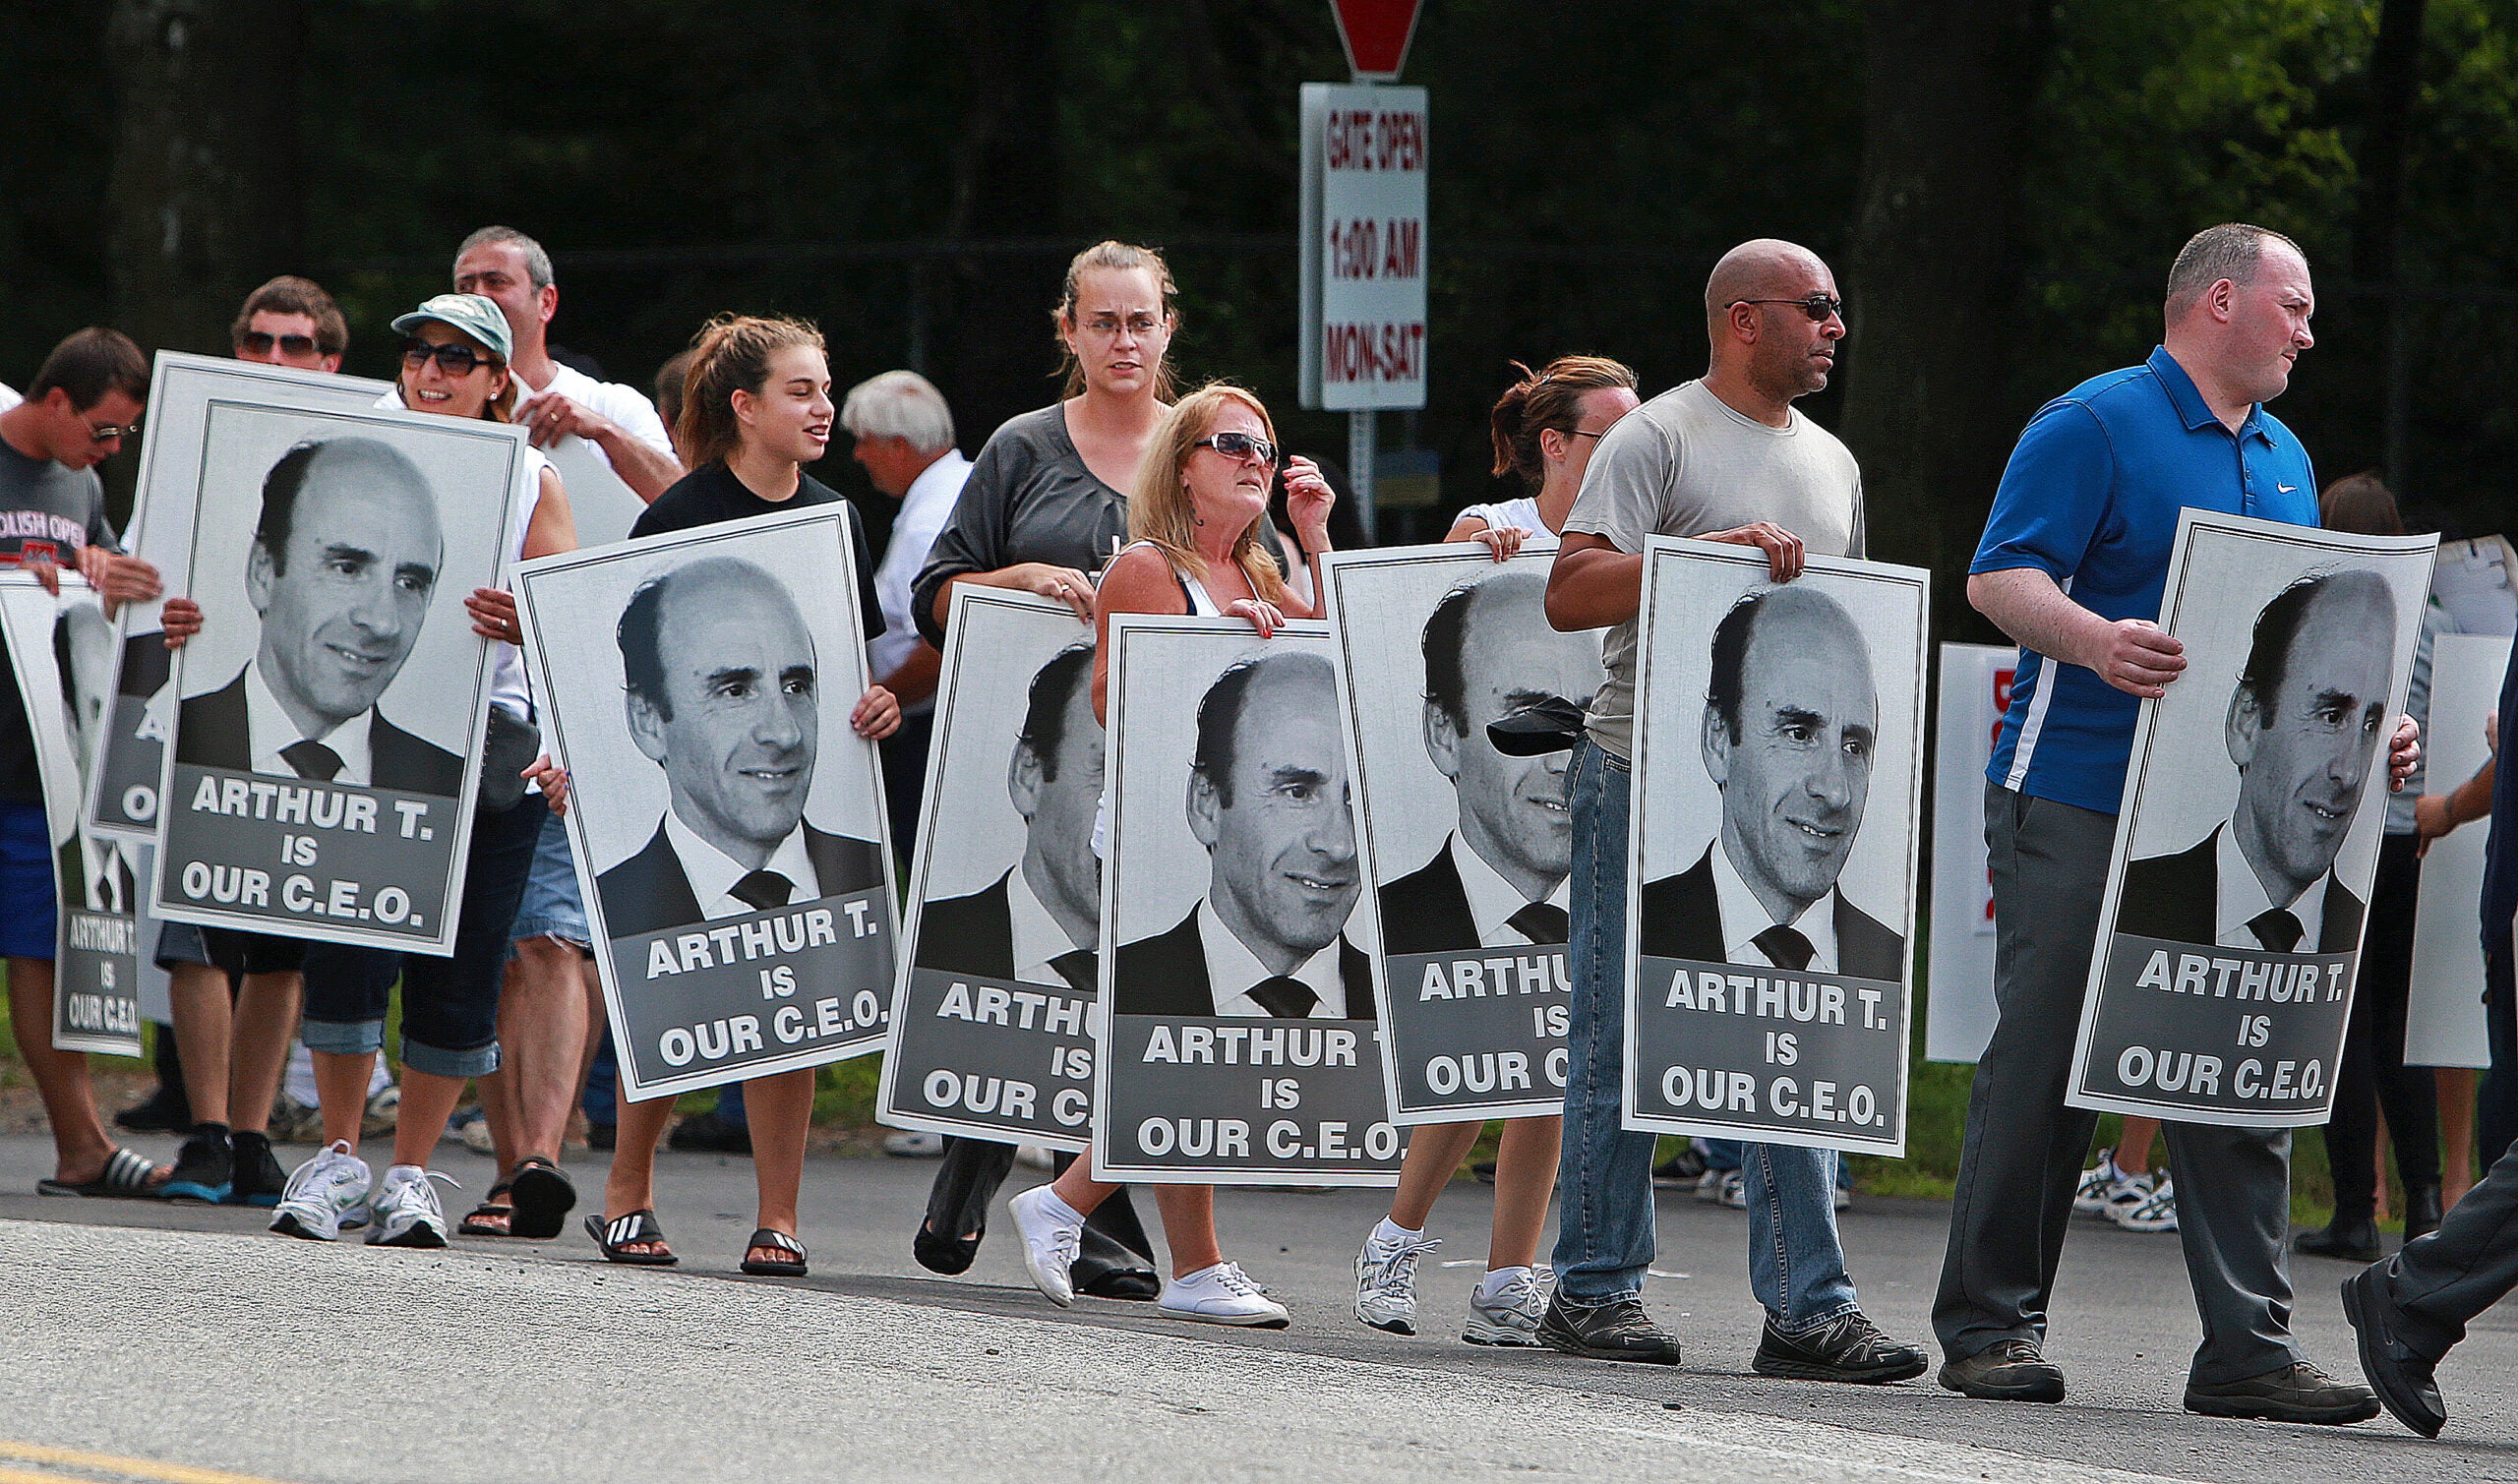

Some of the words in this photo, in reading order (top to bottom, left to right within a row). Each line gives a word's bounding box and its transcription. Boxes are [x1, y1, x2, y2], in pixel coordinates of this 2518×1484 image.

[1329, 109, 1372, 169] GATE
[1378, 110, 1425, 171] OPEN
[1383, 218, 1419, 280] AM
[1326, 323, 1424, 383] MON-SAT
[0, 510, 48, 538] OLISH
[192, 775, 378, 834] ARTHUR
[394, 800, 433, 841] T.
[281, 834, 318, 867] IS
[182, 861, 270, 908] OUR
[281, 874, 424, 927] C.E.O.
[70, 915, 126, 955] ARTHUR
[646, 909, 836, 980] ARTHUR
[844, 899, 877, 937] T.
[100, 960, 115, 989] IS
[759, 965, 797, 999] IS
[1419, 953, 1571, 1002] ARTHU
[2135, 949, 2319, 1003] ARTHUR
[2326, 963, 2344, 1002] T.
[69, 991, 103, 1031] OUR
[935, 982, 1098, 1039] ARTH
[1532, 1004, 1570, 1039] IS
[1665, 969, 1845, 1026] ARTHUR
[1858, 988, 1887, 1031] T.
[658, 1014, 763, 1067] OUR
[773, 989, 889, 1044] C.E.O.
[1142, 1025, 1357, 1067] ARTHUR
[1765, 1031, 1798, 1066] IS
[2238, 1015, 2271, 1047] IS
[1050, 1045, 1092, 1080] IS
[1425, 1051, 1531, 1096] OUR
[2118, 1045, 2223, 1096] OUR
[2235, 1058, 2324, 1099] C.E.O.
[923, 1068, 1037, 1120] OUR
[1261, 1078, 1300, 1110] IS
[1661, 1065, 1757, 1113] OUR
[1769, 1076, 1885, 1127] C.E.O.
[1137, 1116, 1250, 1158] OUR
[1266, 1118, 1408, 1160] C.E.O.
